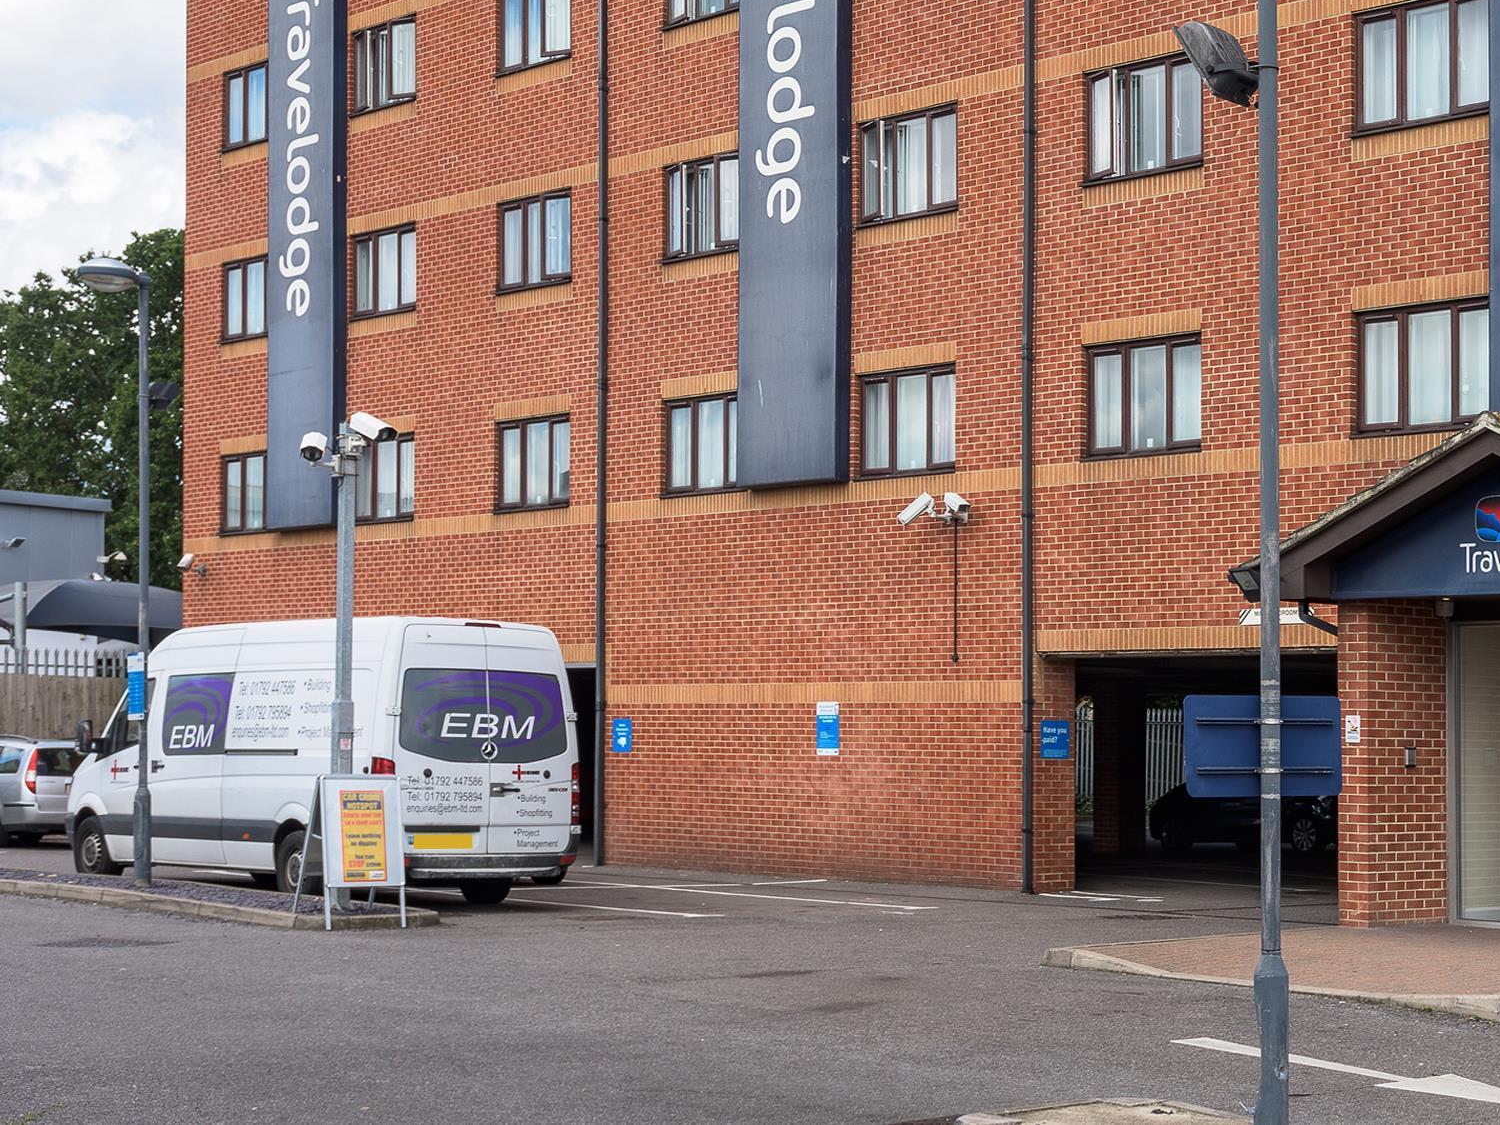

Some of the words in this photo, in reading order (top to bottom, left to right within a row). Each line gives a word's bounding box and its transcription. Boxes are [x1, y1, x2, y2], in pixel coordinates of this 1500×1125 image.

[440, 712, 536, 740] EBM
[169, 723, 215, 749] EBM
[407, 776, 422, 786] Tel:
[424, 776, 451, 786] 01792
[453, 776, 483, 786] 447586
[407, 792, 422, 802] Tel:
[424, 792, 450, 802] 01792
[453, 792, 483, 802] 795894
[520, 795, 547, 804] Building
[519, 809, 552, 818] Shopfitting
[516, 828, 540, 838] Project
[516, 840, 559, 849] Management
